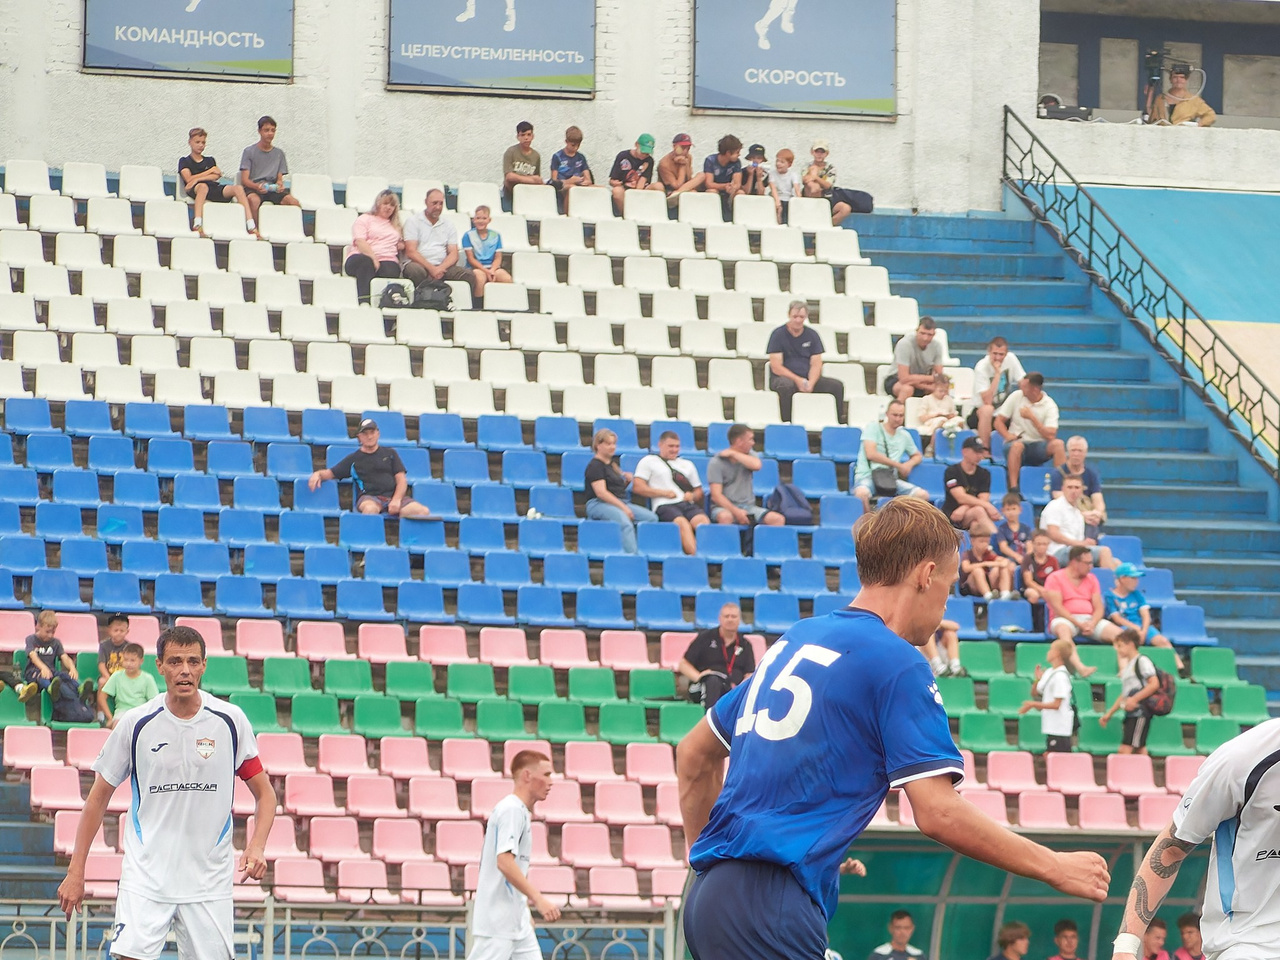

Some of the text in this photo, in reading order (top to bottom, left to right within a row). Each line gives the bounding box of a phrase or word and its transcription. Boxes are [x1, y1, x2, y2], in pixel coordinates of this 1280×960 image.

[114, 25, 265, 49] КОМАНДНОСТЬ
[401, 43, 585, 64] ЦЕЛЕУСТРЕМЛЕННОСТЬ
[744, 68, 846, 87] СКОРОСТЬ
[735, 640, 842, 741] 15
